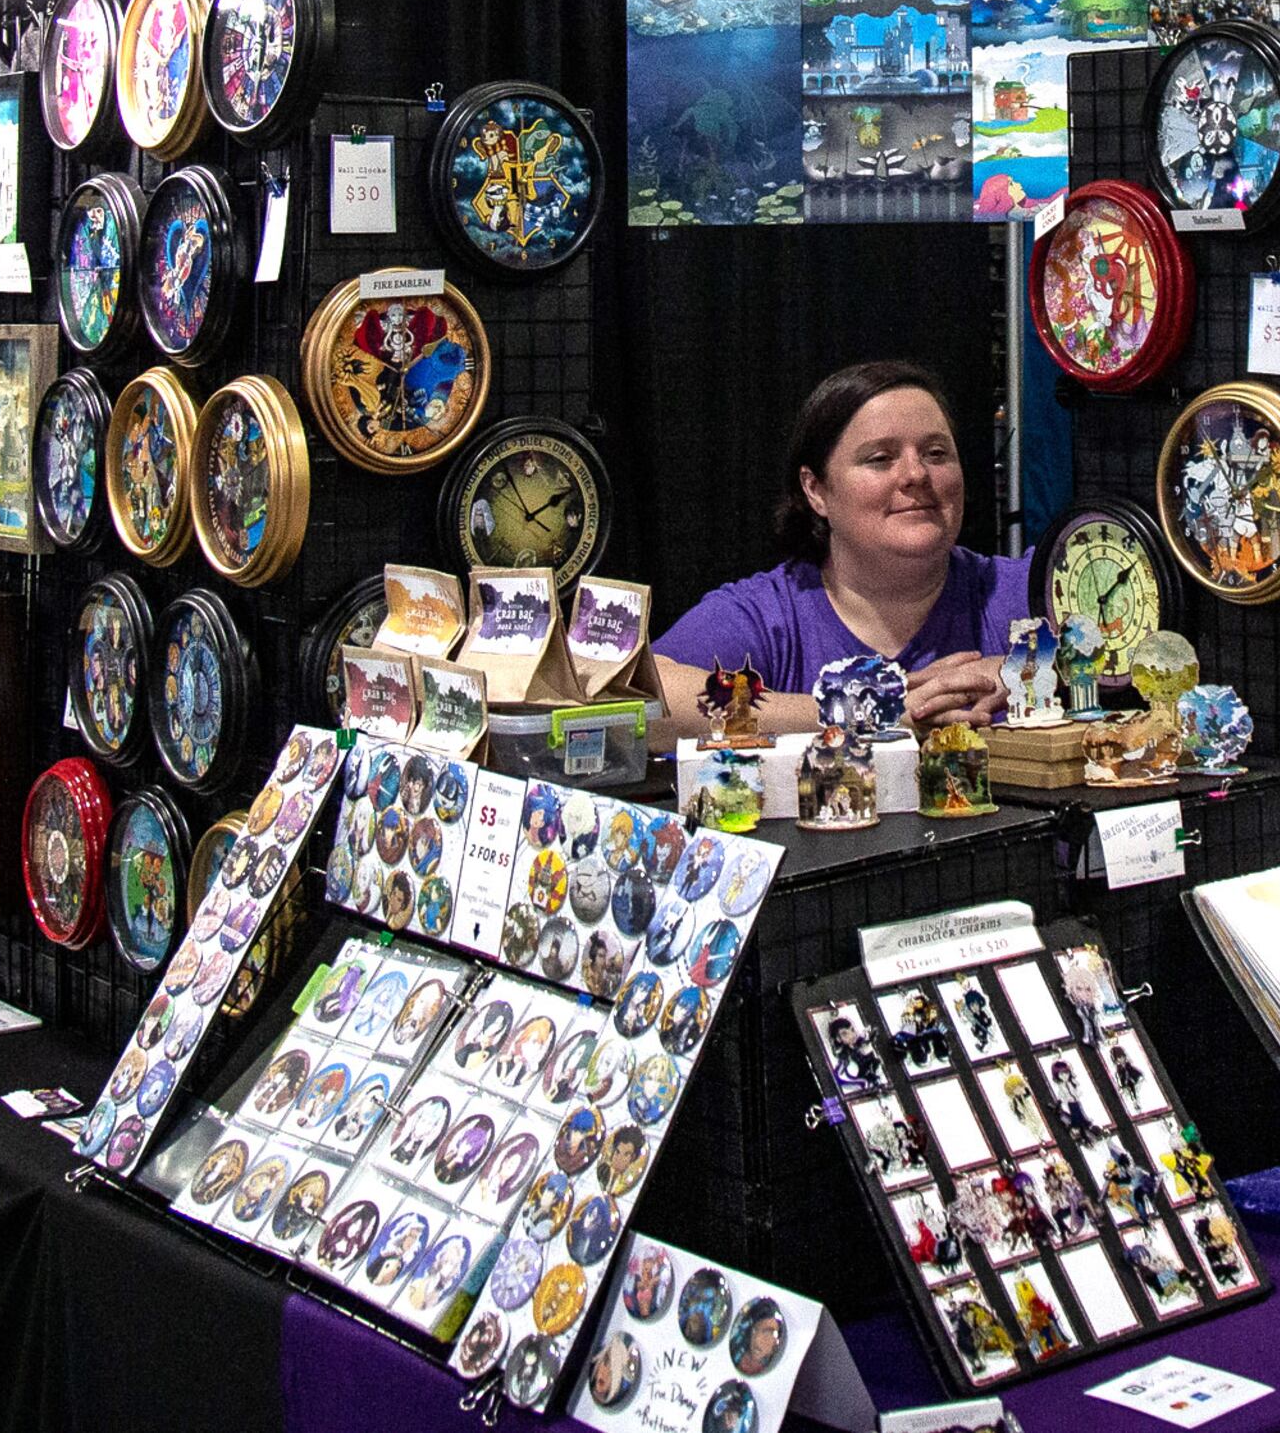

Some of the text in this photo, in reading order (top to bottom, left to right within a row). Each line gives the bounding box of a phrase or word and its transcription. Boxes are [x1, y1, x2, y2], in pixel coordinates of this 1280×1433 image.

[356, 166, 387, 174] Clocks
[346, 184, 380, 204] $30
[373, 279, 431, 290] FIRE EMBLEM
[519, 436, 546, 448] DUEL
[551, 441, 575, 464] DUEL
[518, 609, 535, 623] BAG
[487, 782, 512, 797] Buttons
[480, 805, 497, 827] $3
[1101, 814, 1140, 841] ORIGINAL
[1128, 813, 1161, 839] ARTWORK
[469, 843, 511, 868] 2 FOR $5
[896, 918, 1002, 949] CHARACTER CHARMS
[896, 958, 916, 974] $12
[986, 938, 1009, 953] $20
[663, 1347, 708, 1373] NEW
